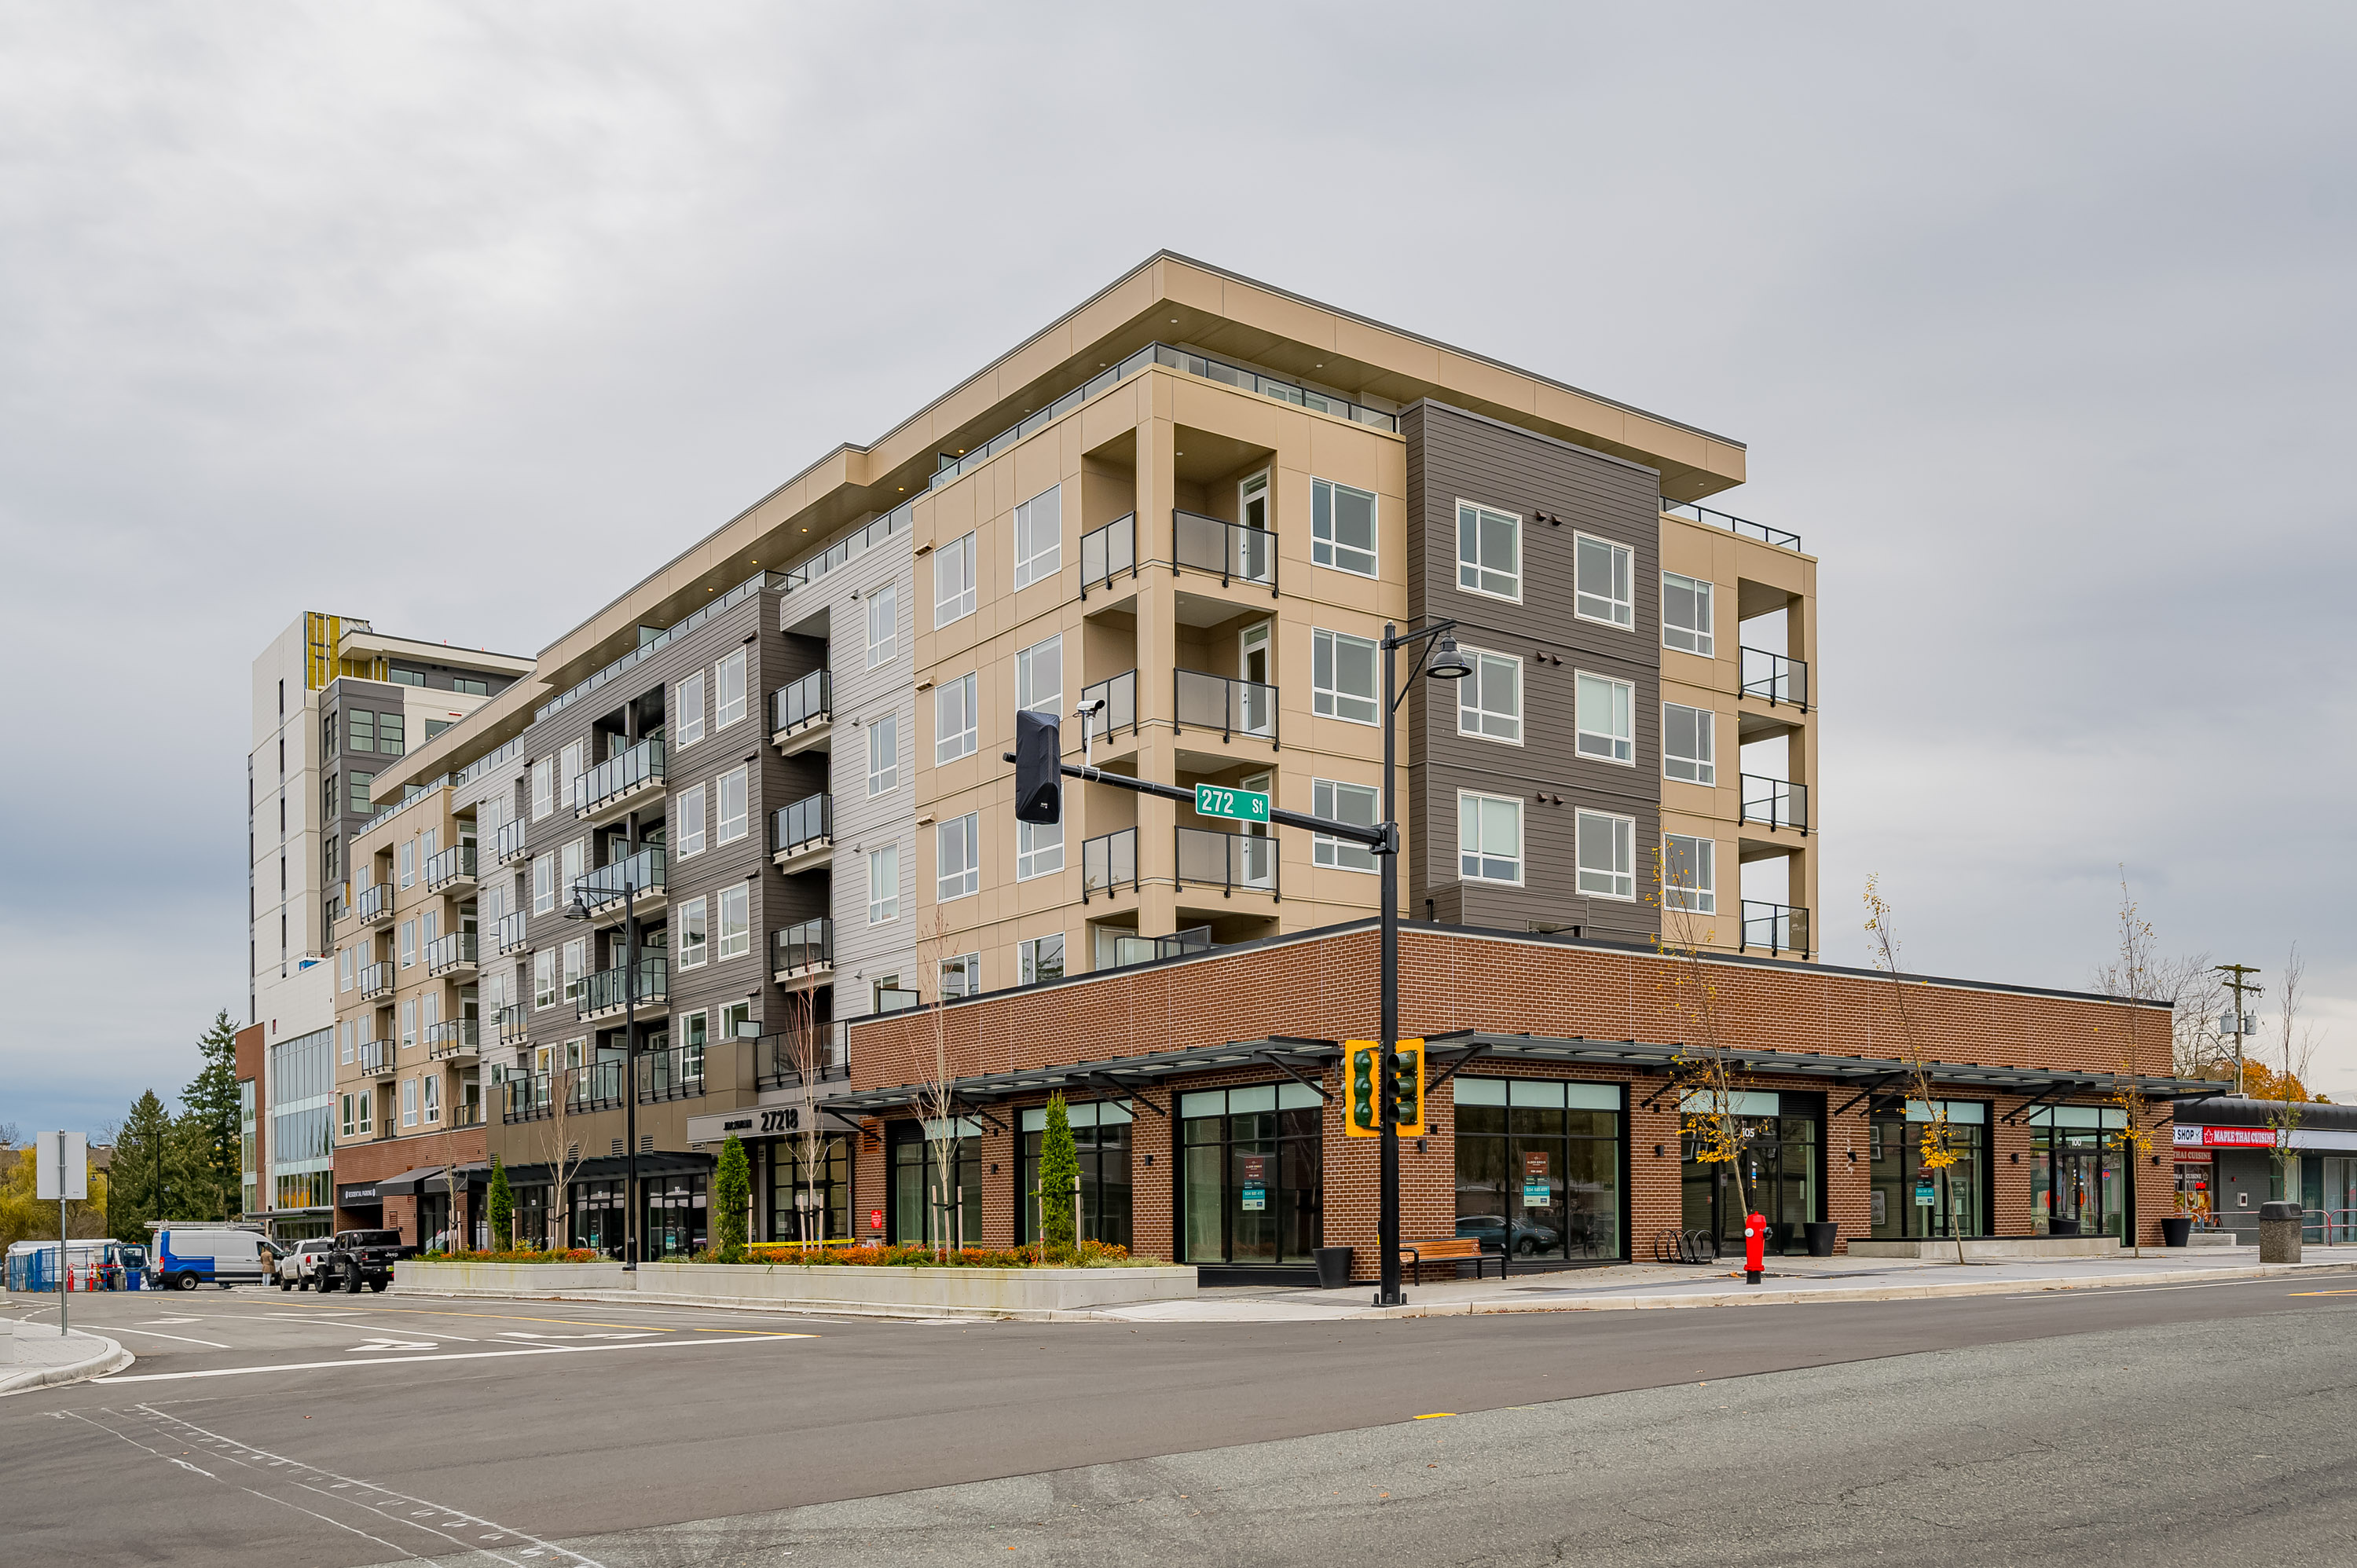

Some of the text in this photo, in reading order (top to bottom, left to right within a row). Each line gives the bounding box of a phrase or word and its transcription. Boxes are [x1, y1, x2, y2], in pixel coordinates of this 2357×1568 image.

[1202, 789, 1263, 814] 272 St
[761, 1108, 798, 1132] 27218
[1743, 1128, 1755, 1138] 105
[2177, 1129, 2194, 1141] SHOP
[2214, 1130, 2275, 1145] MAPLE THAI CUISINE
[2072, 1138, 2082, 1147] 100
[2188, 1151, 2211, 1160] CUISINE
